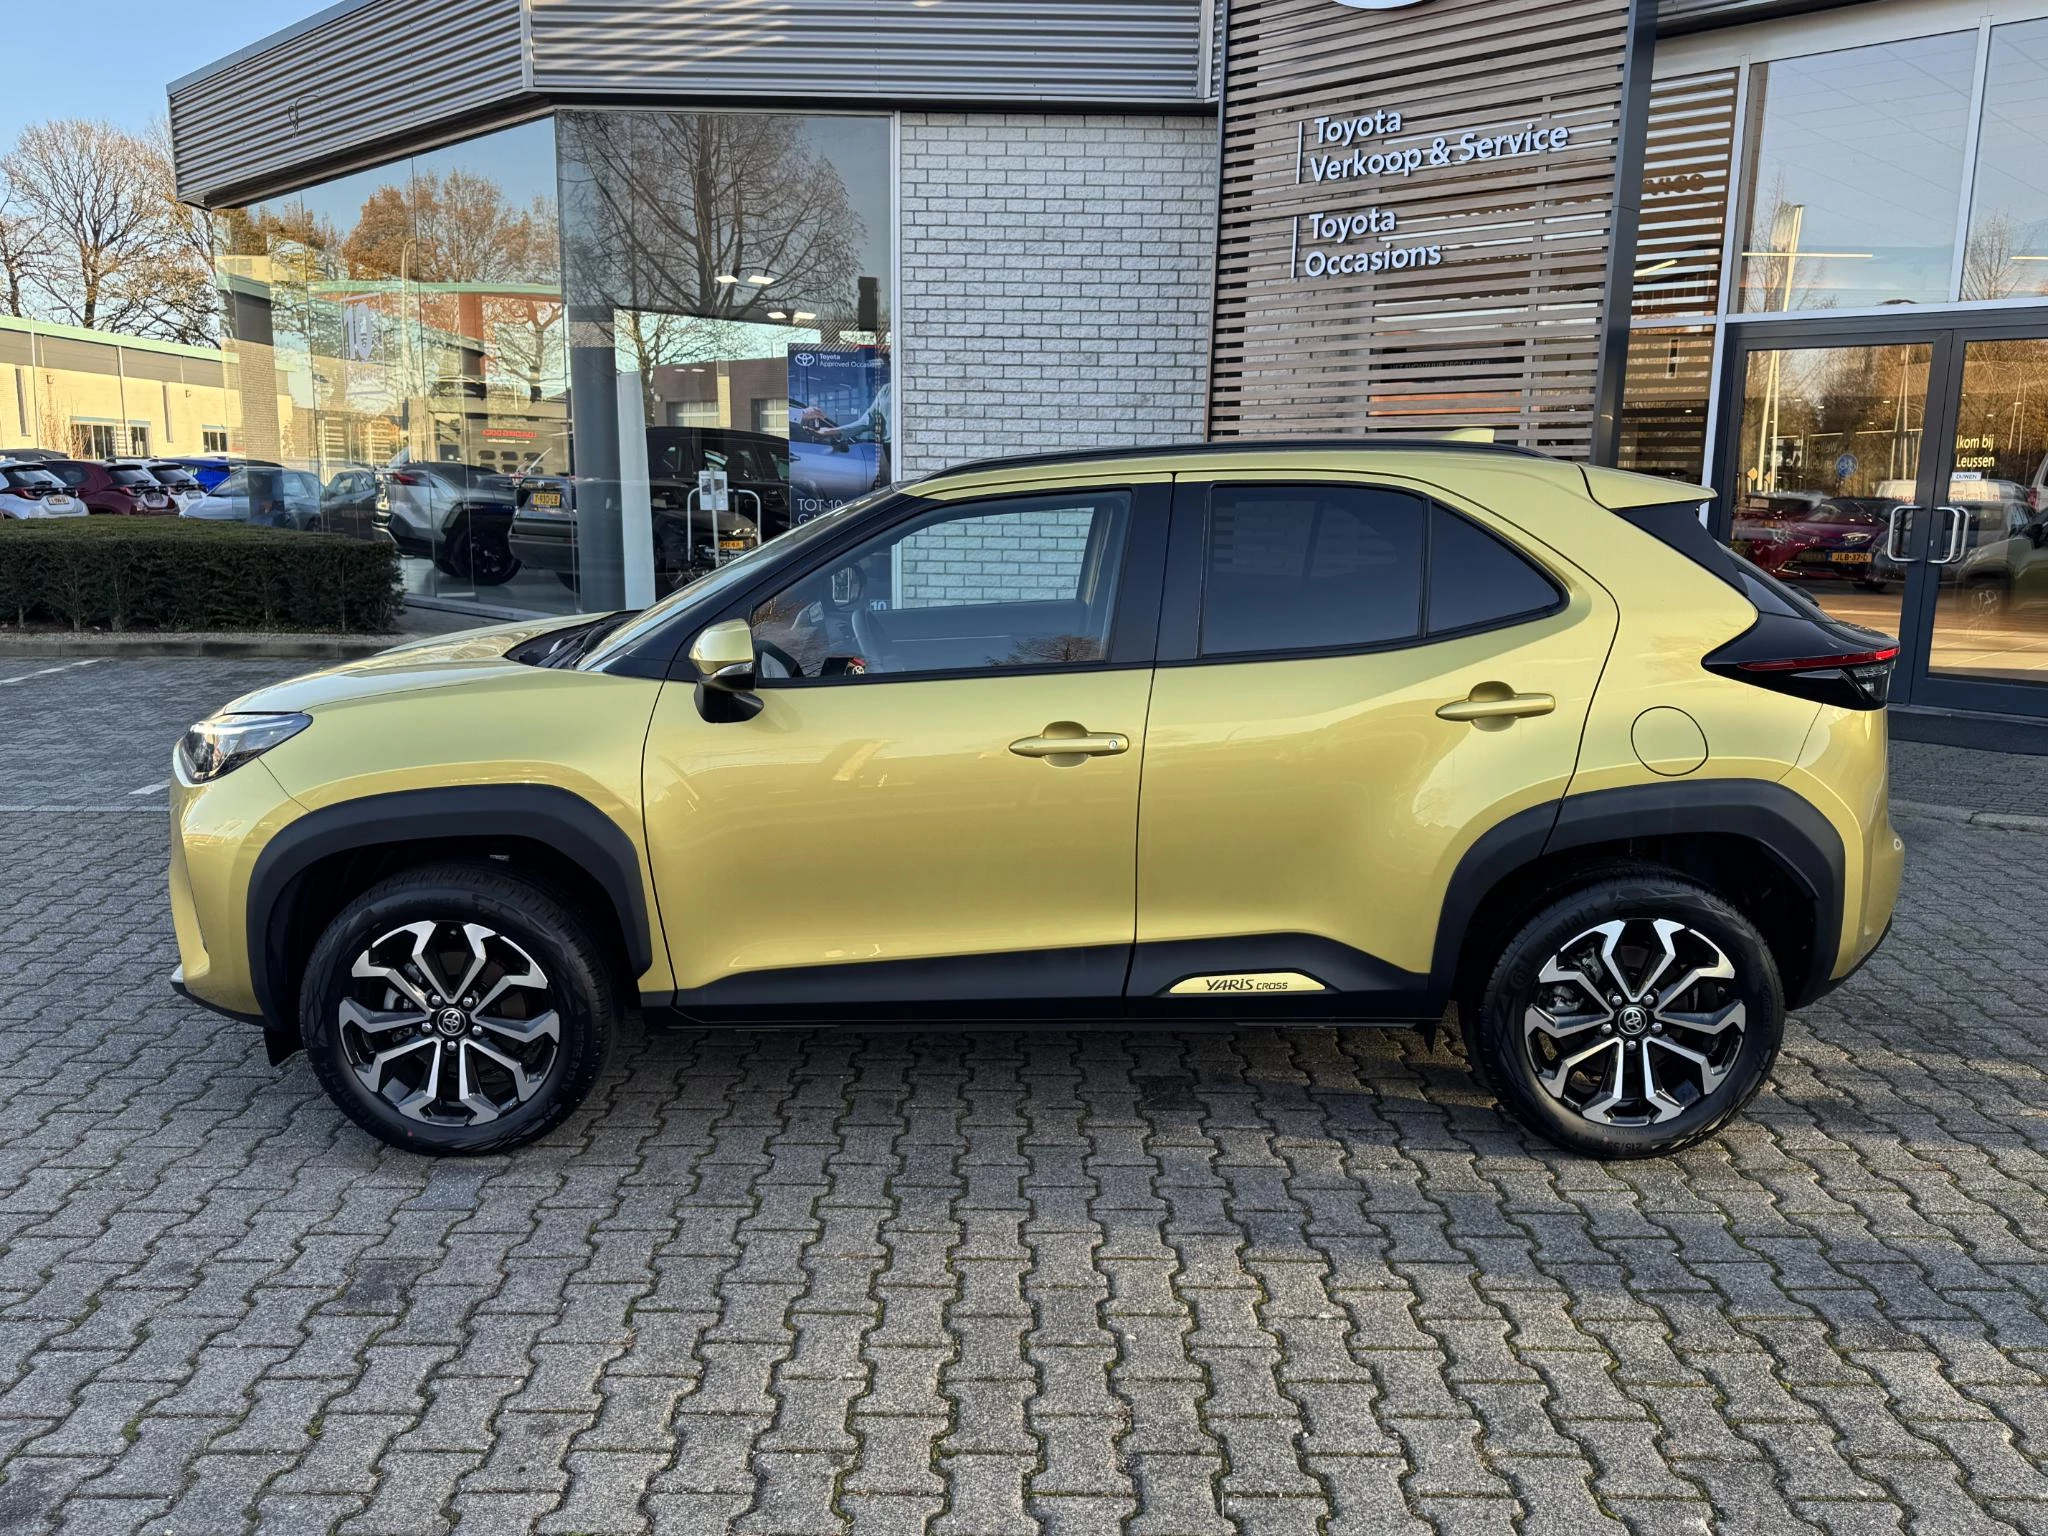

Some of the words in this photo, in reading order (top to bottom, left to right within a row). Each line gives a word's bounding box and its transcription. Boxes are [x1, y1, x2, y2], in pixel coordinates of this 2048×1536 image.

[1314, 109, 1402, 147] Toyota
[1310, 148, 1422, 182] Verkoop
[1429, 139, 1450, 166] &
[1459, 123, 1570, 163] Service
[1309, 208, 1396, 243] Toyota
[1304, 242, 1442, 278] Occasions
[1981, 433, 1995, 452] bij
[1956, 453, 1995, 468] Leussen
[797, 498, 824, 512] TOT
[1206, 979, 1254, 991] YARIS
[1256, 982, 1288, 990] CROSS
